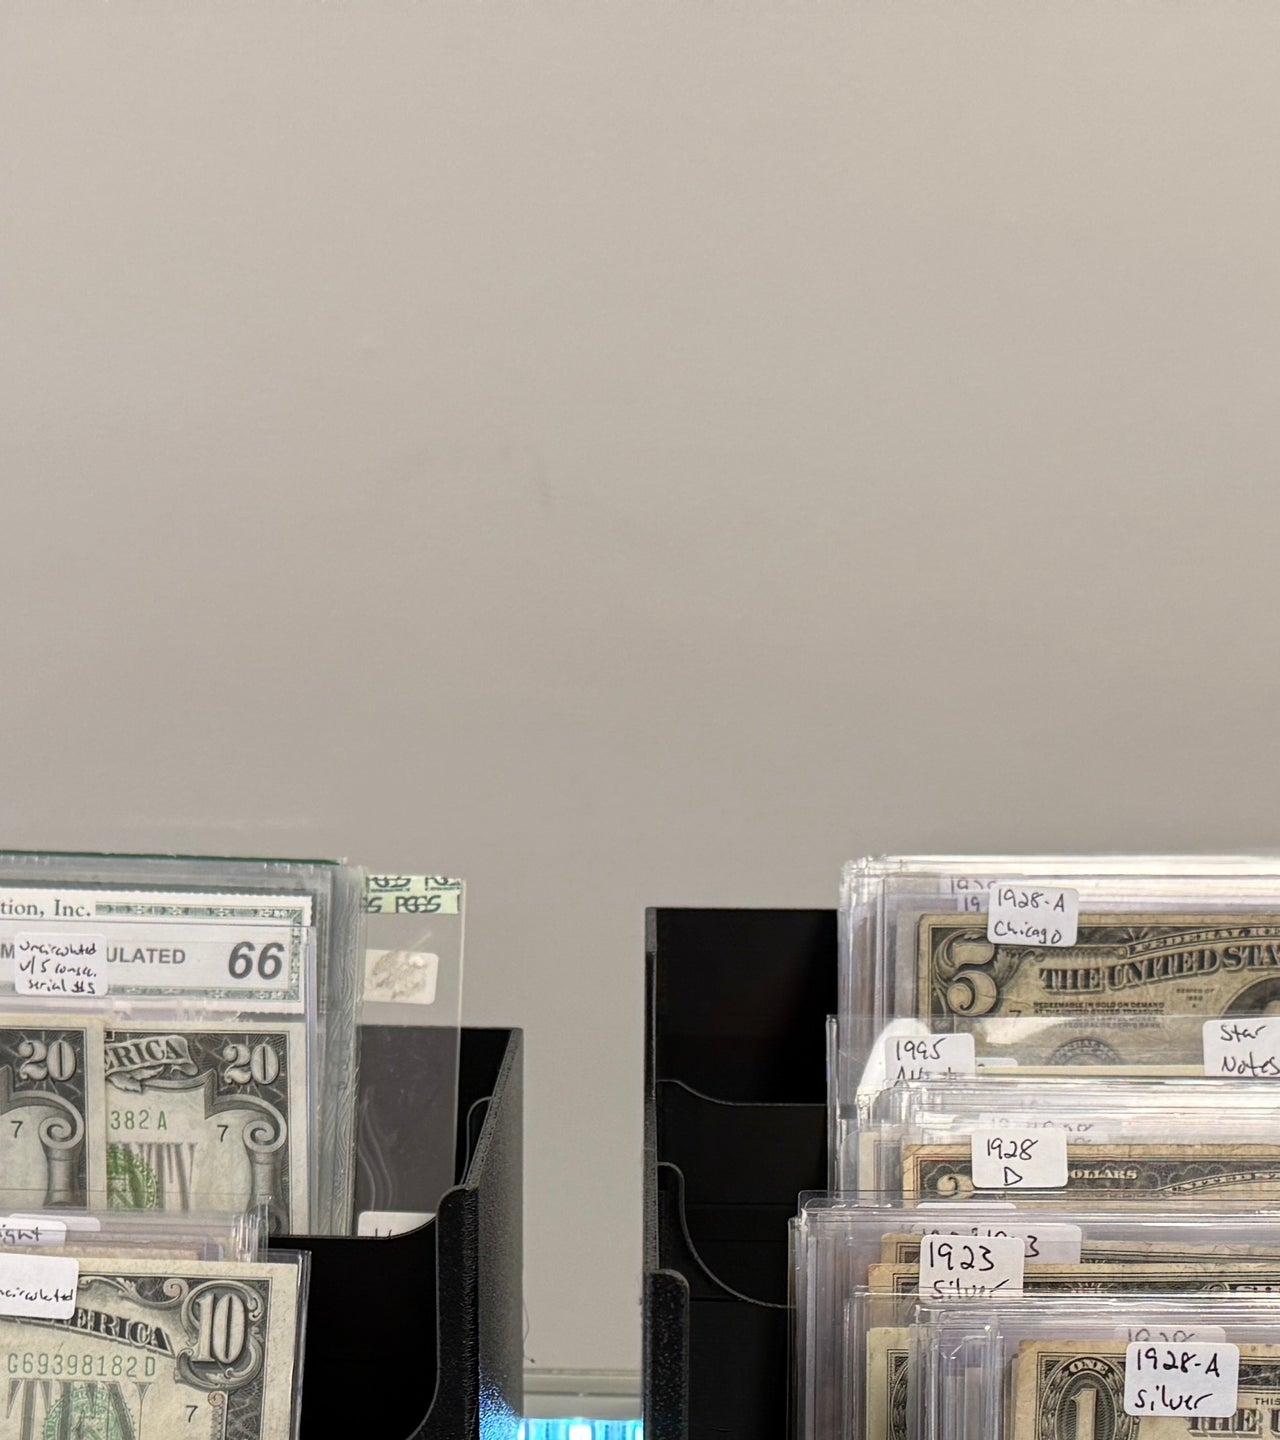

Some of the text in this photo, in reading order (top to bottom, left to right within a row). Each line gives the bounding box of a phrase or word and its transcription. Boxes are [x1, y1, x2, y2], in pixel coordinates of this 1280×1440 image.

[54, 899, 91, 918] Inc.
[998, 889, 1065, 912] 1928-A
[994, 920, 1062, 944] Chicago
[228, 941, 285, 981] 66
[1040, 967, 1105, 993] THE
[1107, 946, 1221, 989] UNITED
[947, 943, 997, 1016] 5
[1220, 1024, 1267, 1043] Star
[20, 1040, 77, 1082] 20
[896, 1038, 946, 1060] 1995
[224, 1044, 280, 1084] 20
[1221, 1055, 1280, 1077] Notes
[11, 1120, 23, 1139] 7
[158, 1111, 167, 1130] A
[217, 1125, 229, 1143] 7
[986, 1136, 1039, 1161] 1928
[1003, 1166, 1024, 1187] D
[929, 1241, 996, 1272] 1923
[190, 1292, 252, 1364] 10
[7, 1354, 156, 1378] G69398182 D
[1067, 1358, 1110, 1376] ONE
[1136, 1348, 1220, 1377] 1928-A
[1135, 1386, 1212, 1411] Silver
[184, 1405, 199, 1424] 7
